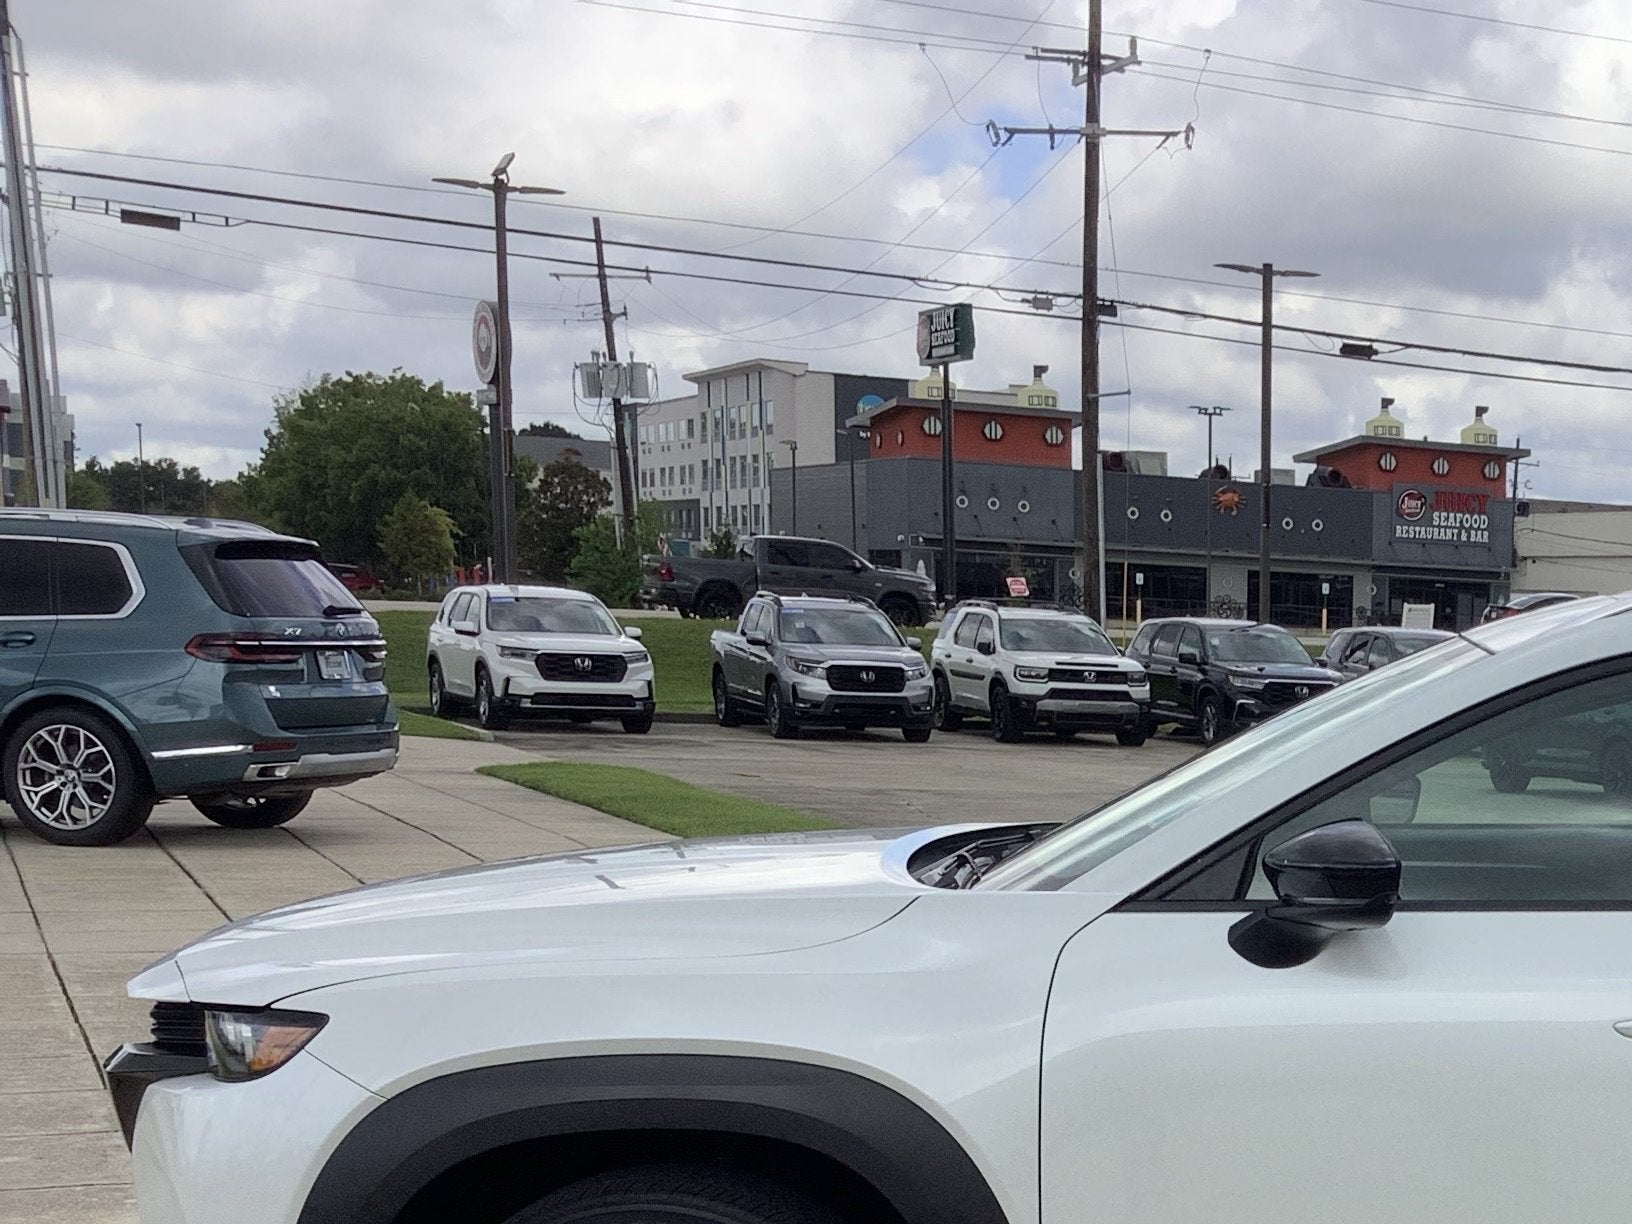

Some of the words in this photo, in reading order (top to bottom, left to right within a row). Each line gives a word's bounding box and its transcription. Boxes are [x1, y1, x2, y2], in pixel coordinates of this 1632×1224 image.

[931, 307, 955, 332] JUICY
[1431, 491, 1490, 514] JUICY
[1432, 511, 1489, 529] SEAFOOD
[1395, 525, 1459, 541] RESTAURANT
[1460, 529, 1468, 541] &
[1470, 530, 1489, 543] BAR
[284, 627, 302, 636] X7
